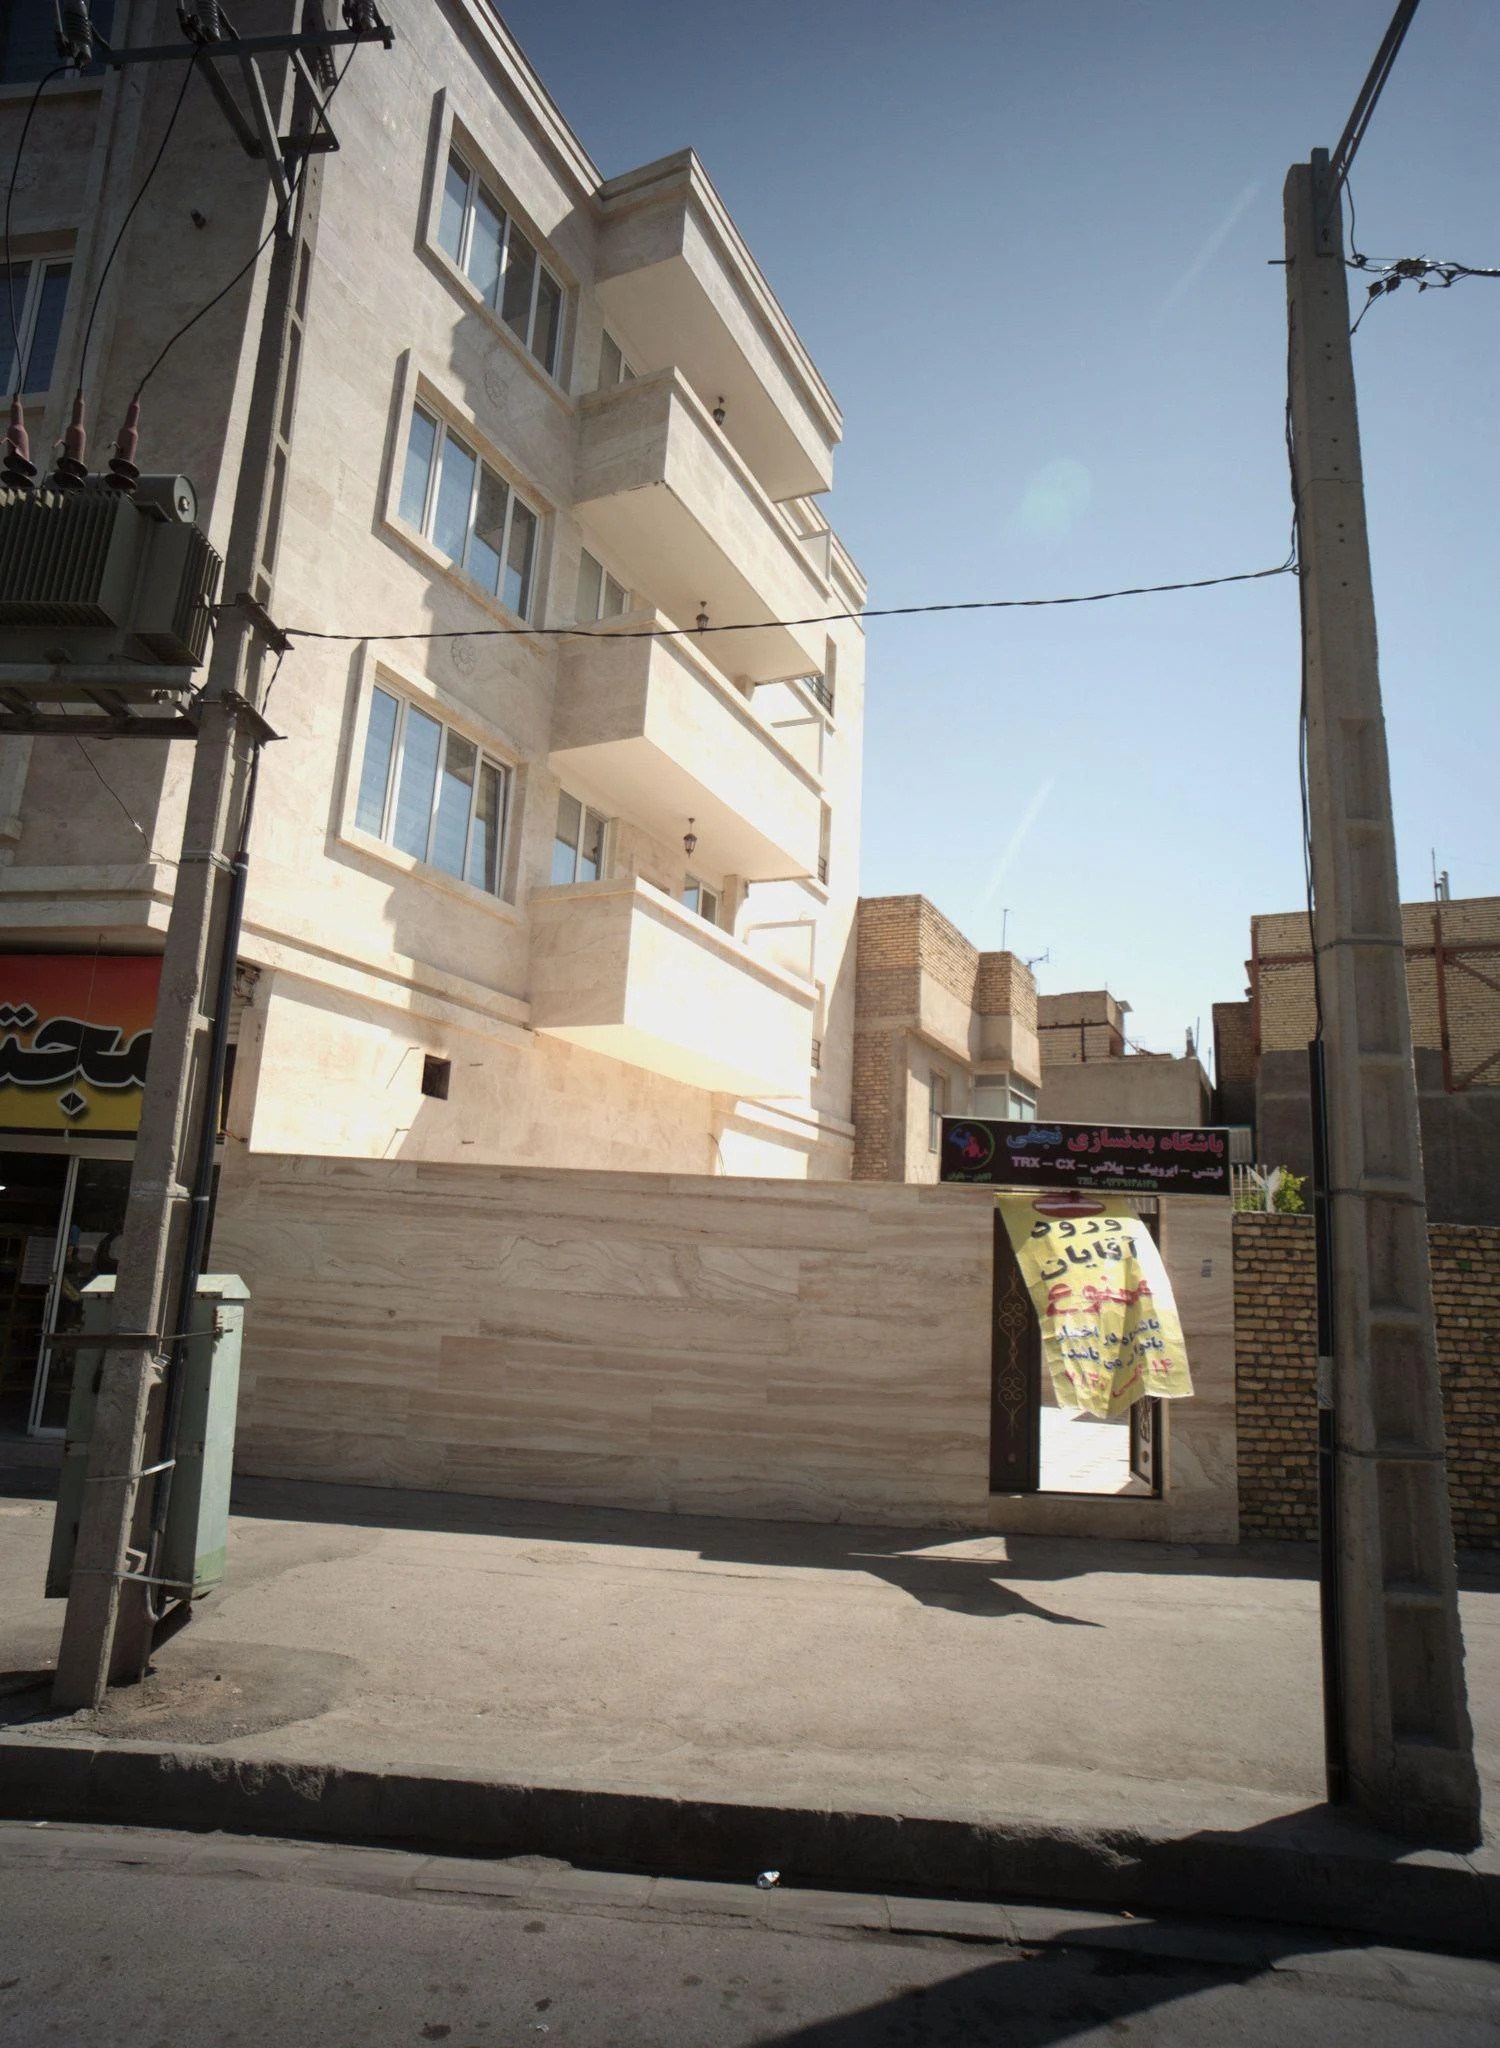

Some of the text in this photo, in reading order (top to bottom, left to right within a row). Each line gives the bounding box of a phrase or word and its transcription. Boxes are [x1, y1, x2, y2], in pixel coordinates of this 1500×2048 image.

[1006, 1125, 1224, 1158] باشگاه بدنسازی نجفی
[1011, 1156, 1041, 1168] TRX
[1055, 1159, 1077, 1170] CX
[1031, 1219, 1122, 1239] ورود
[1046, 1275, 1154, 1318] ممنوع
